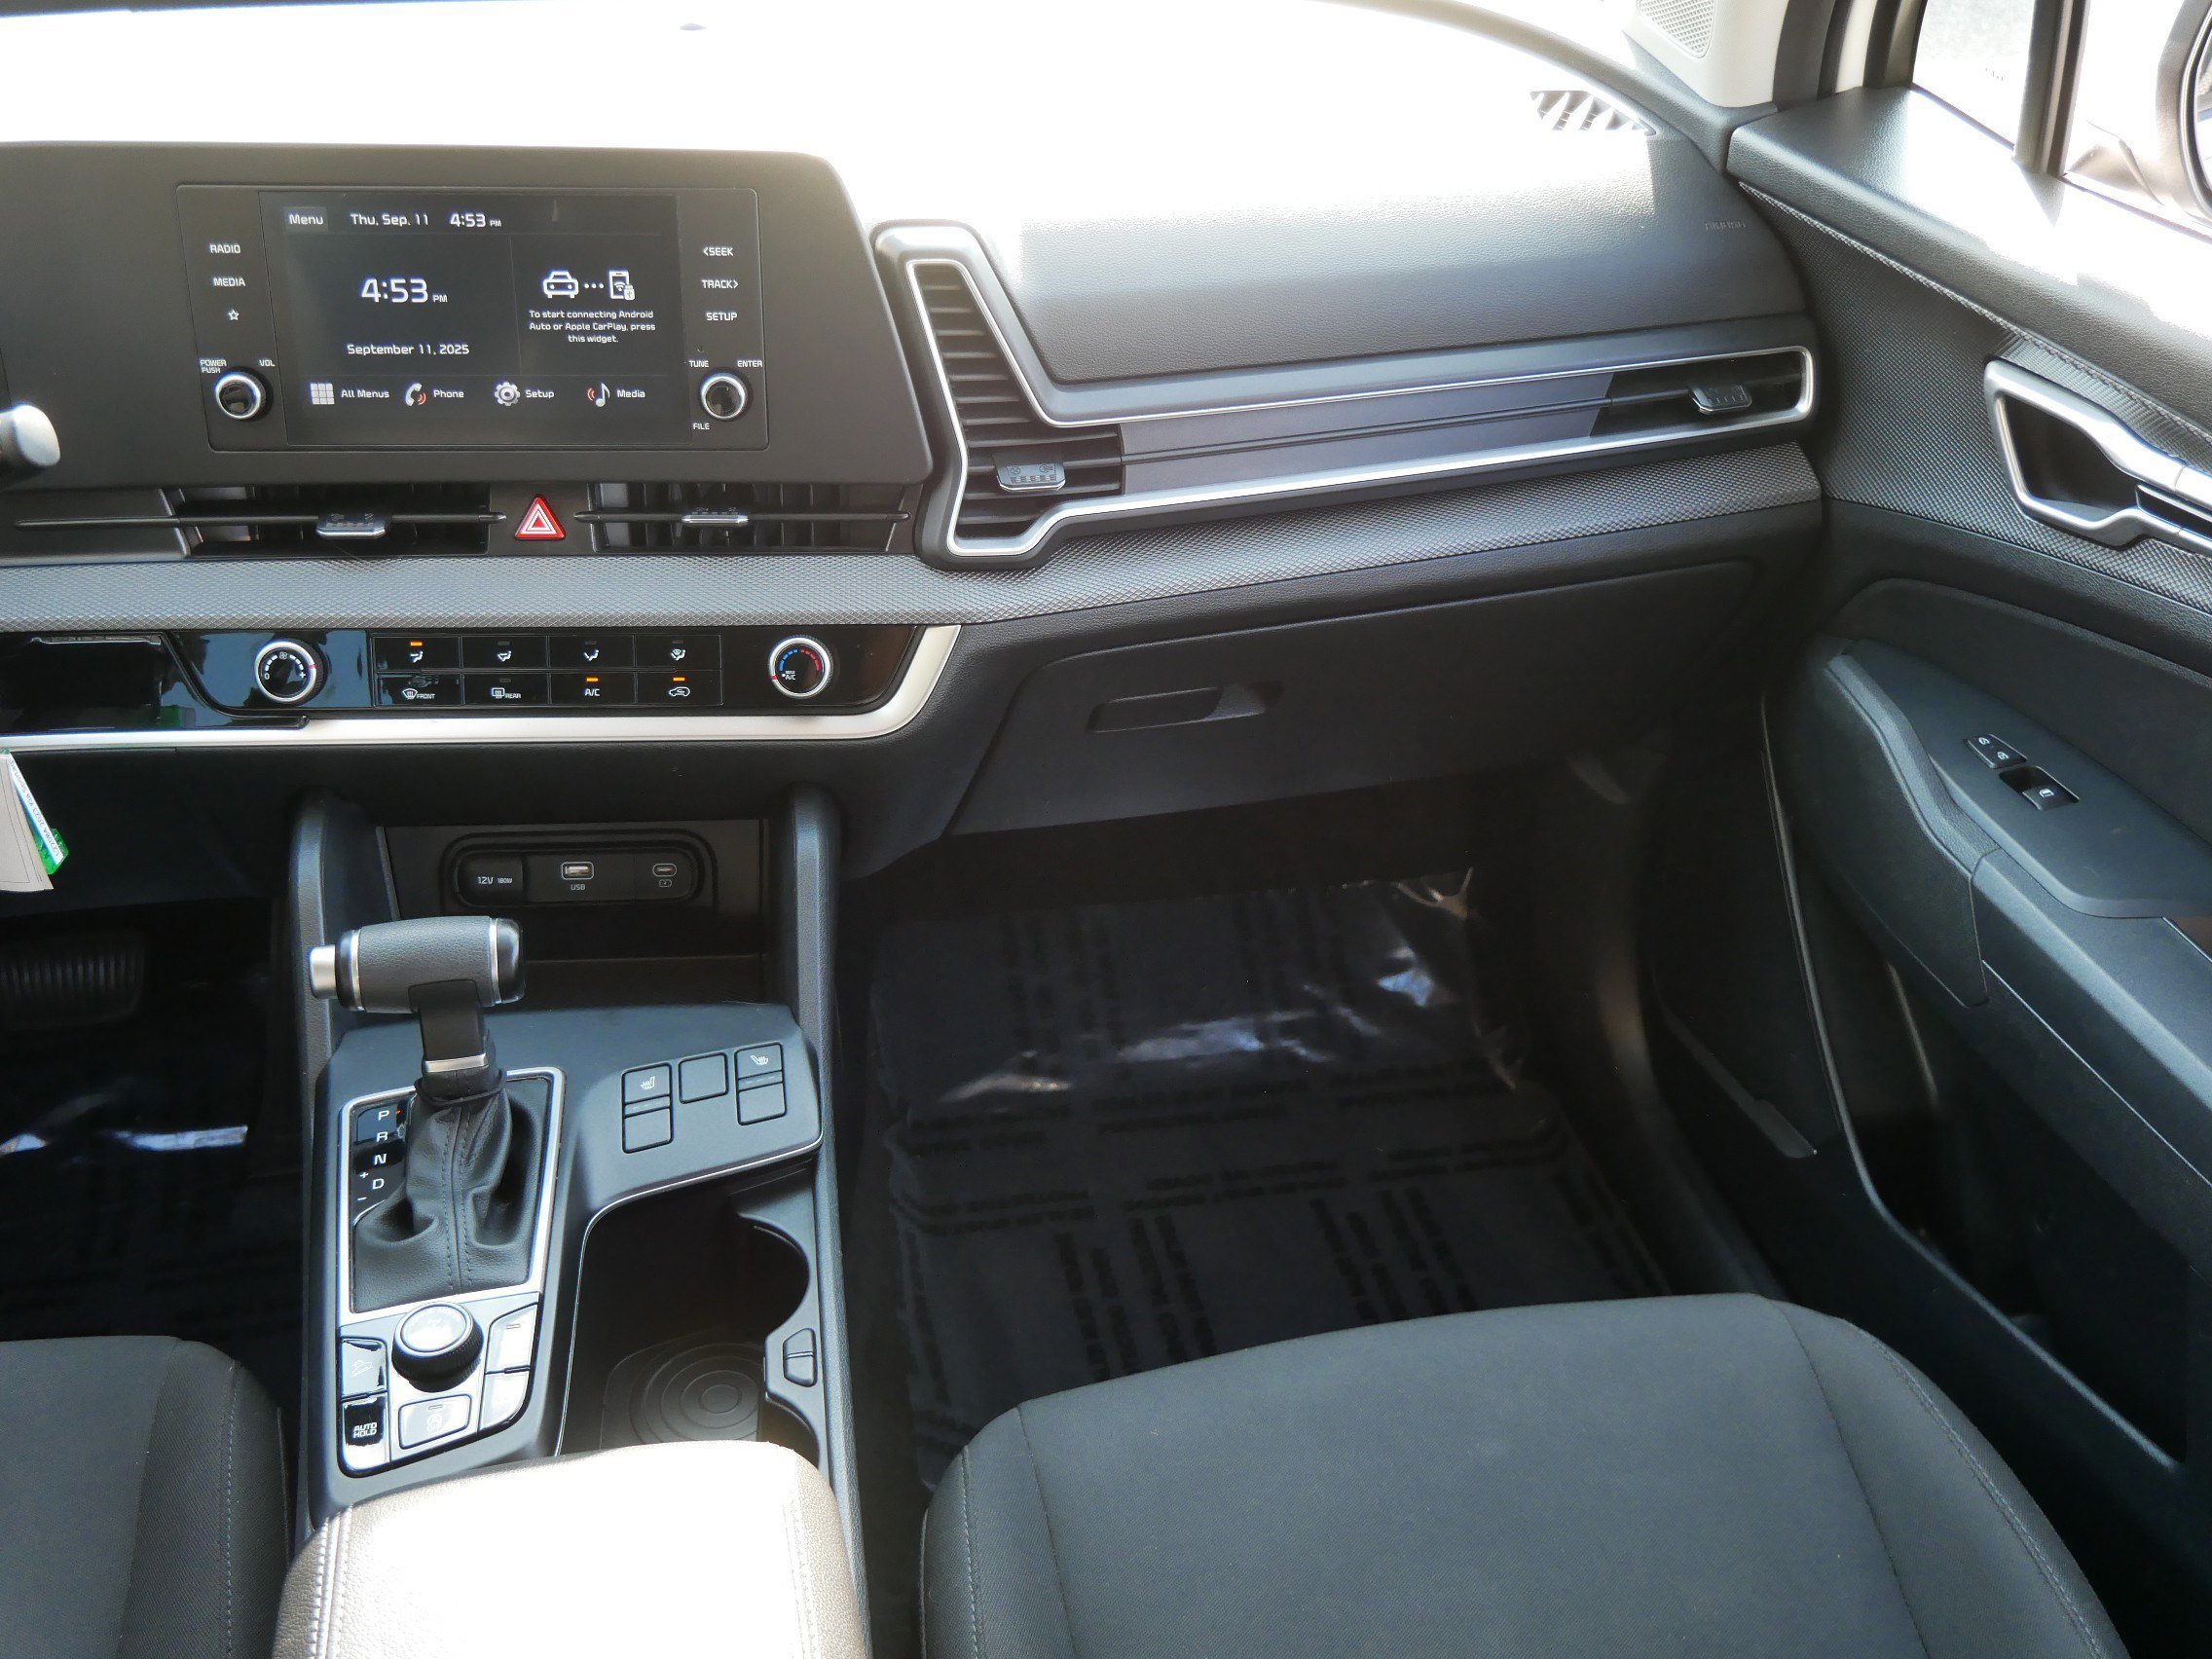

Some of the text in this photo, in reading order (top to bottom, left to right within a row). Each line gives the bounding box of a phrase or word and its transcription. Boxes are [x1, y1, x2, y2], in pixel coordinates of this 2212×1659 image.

[289, 214, 324, 226] Menu
[383, 214, 411, 227] Sep.
[415, 214, 429, 226] 11
[450, 213, 487, 228] 4:53
[209, 244, 241, 254] RADIO
[213, 277, 246, 287] MEDIA
[361, 277, 448, 303] 4:53 PM
[567, 311, 617, 320] connecting
[706, 312, 738, 321] SETUP
[529, 322, 552, 331] Auto
[565, 322, 591, 332] Apple
[630, 323, 656, 332] press
[587, 335, 619, 344] widget.
[347, 345, 415, 355] September
[439, 345, 470, 355] 2025
[341, 389, 390, 398] All Menus
[433, 389, 465, 398] Phone
[525, 389, 555, 400] Setup
[616, 389, 646, 398] Media
[584, 688, 601, 697] A/C
[477, 876, 494, 885] 12V
[378, 1110, 390, 1121] P
[376, 1131, 388, 1142] R
[374, 1154, 387, 1165] N
[372, 1178, 385, 1190] D
[353, 1422, 377, 1431] AUTO
[353, 1429, 377, 1438] HOLD
